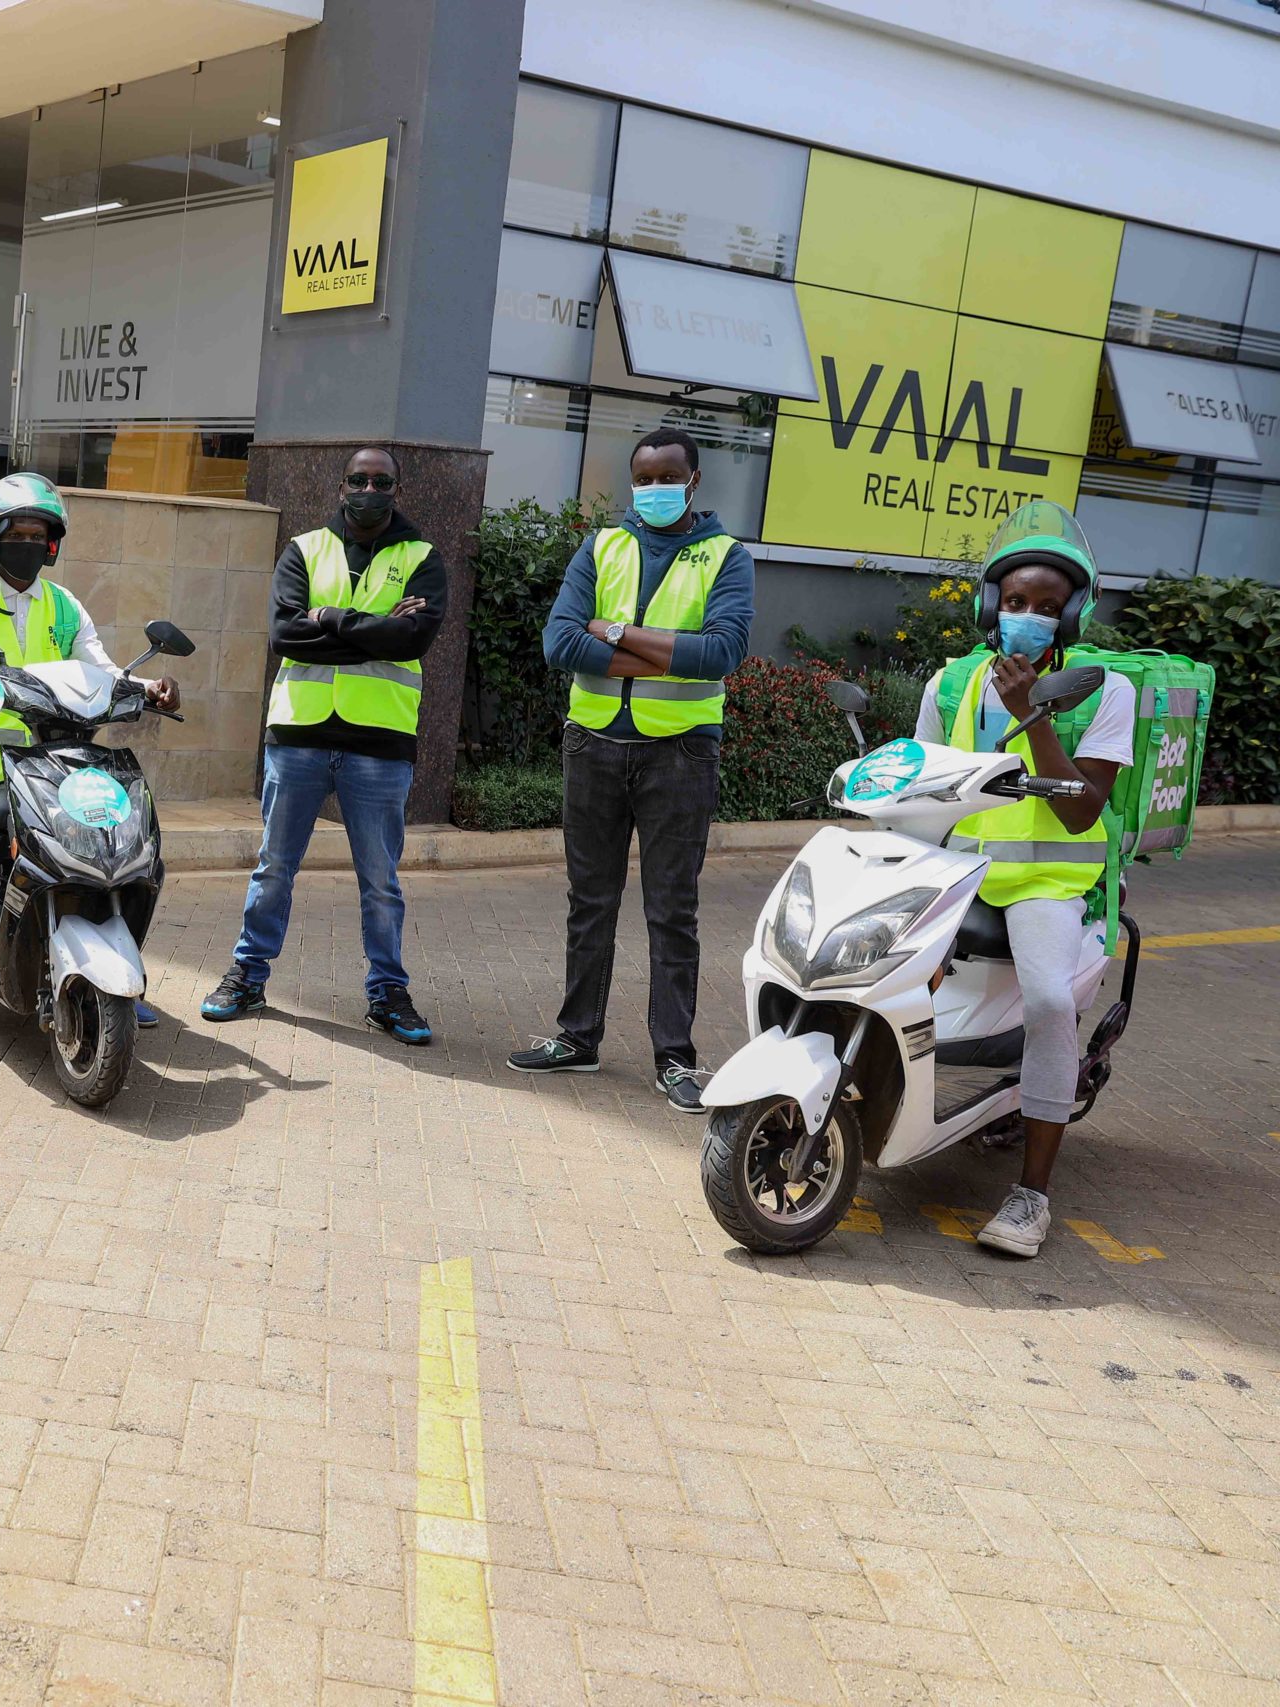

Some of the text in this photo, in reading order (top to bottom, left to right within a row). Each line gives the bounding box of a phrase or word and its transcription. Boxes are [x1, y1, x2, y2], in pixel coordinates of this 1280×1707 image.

[293, 238, 369, 277] VAAL
[306, 273, 367, 293] REAL ESTATE
[60, 321, 138, 360] LIVE &
[56, 365, 148, 402] INVEST
[821, 355, 1050, 477] VAAL
[1167, 392, 1218, 419] ALES
[863, 472, 935, 512] REAL
[1157, 733, 1187, 768] Bolt
[1148, 776, 1189, 814] Food
